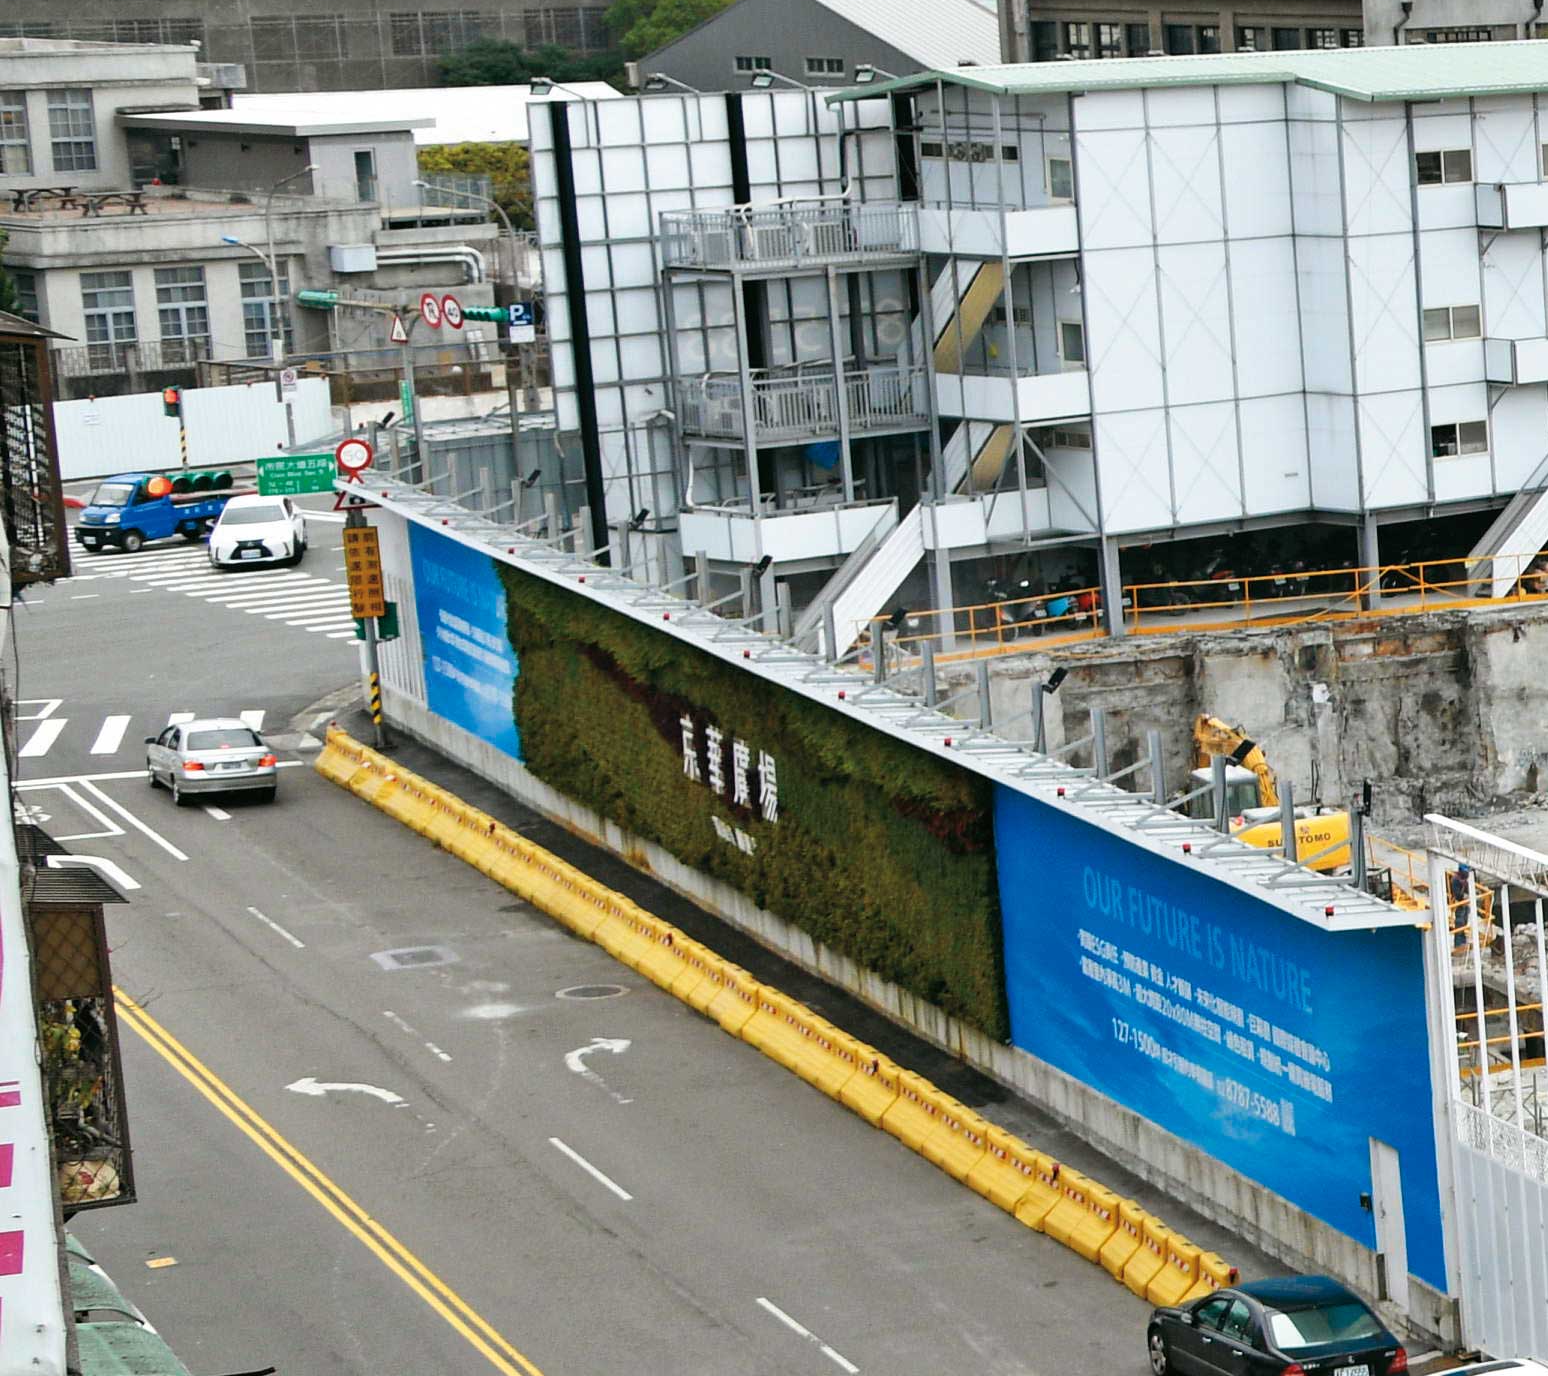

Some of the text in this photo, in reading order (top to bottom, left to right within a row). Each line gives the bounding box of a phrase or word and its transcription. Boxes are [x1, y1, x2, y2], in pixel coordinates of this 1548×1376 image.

[1267, 832, 1332, 848] SUTOMO
[1083, 865, 1125, 923] OUR
[1128, 886, 1202, 961] FUTURE
[1206, 923, 1226, 970] IS
[1230, 931, 1313, 1015] NATURE
